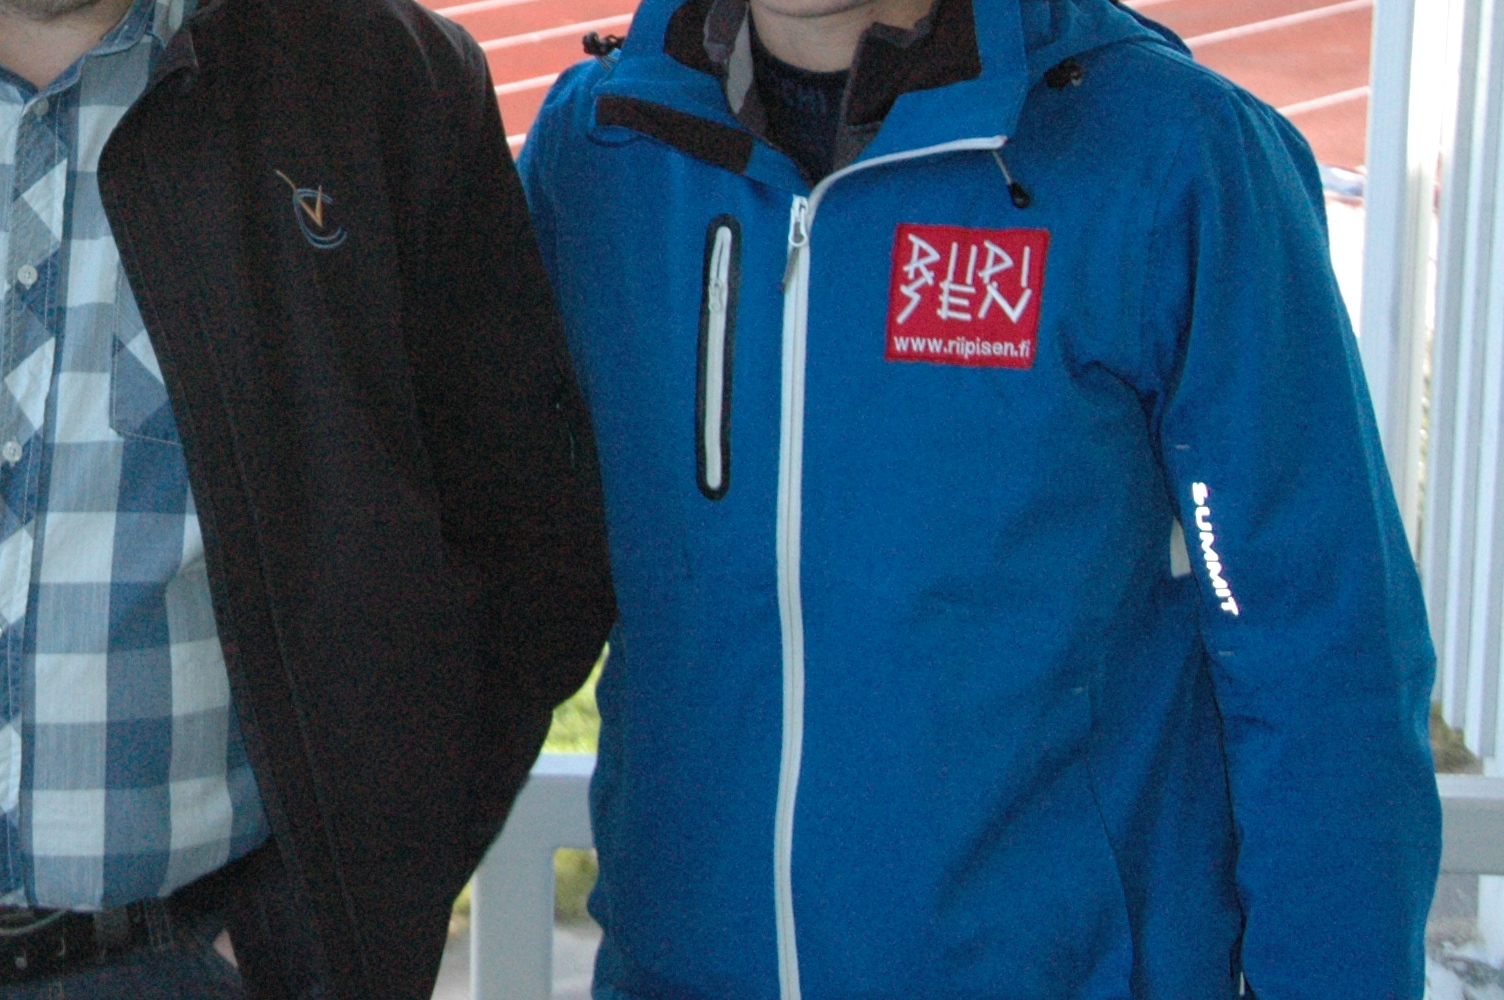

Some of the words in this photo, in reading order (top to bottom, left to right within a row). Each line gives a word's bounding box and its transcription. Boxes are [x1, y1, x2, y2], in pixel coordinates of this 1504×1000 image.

[896, 272, 1032, 324] SEN
[894, 336, 1031, 360] www.riipisen.fi
[1192, 482, 1239, 616] SUMMIT
